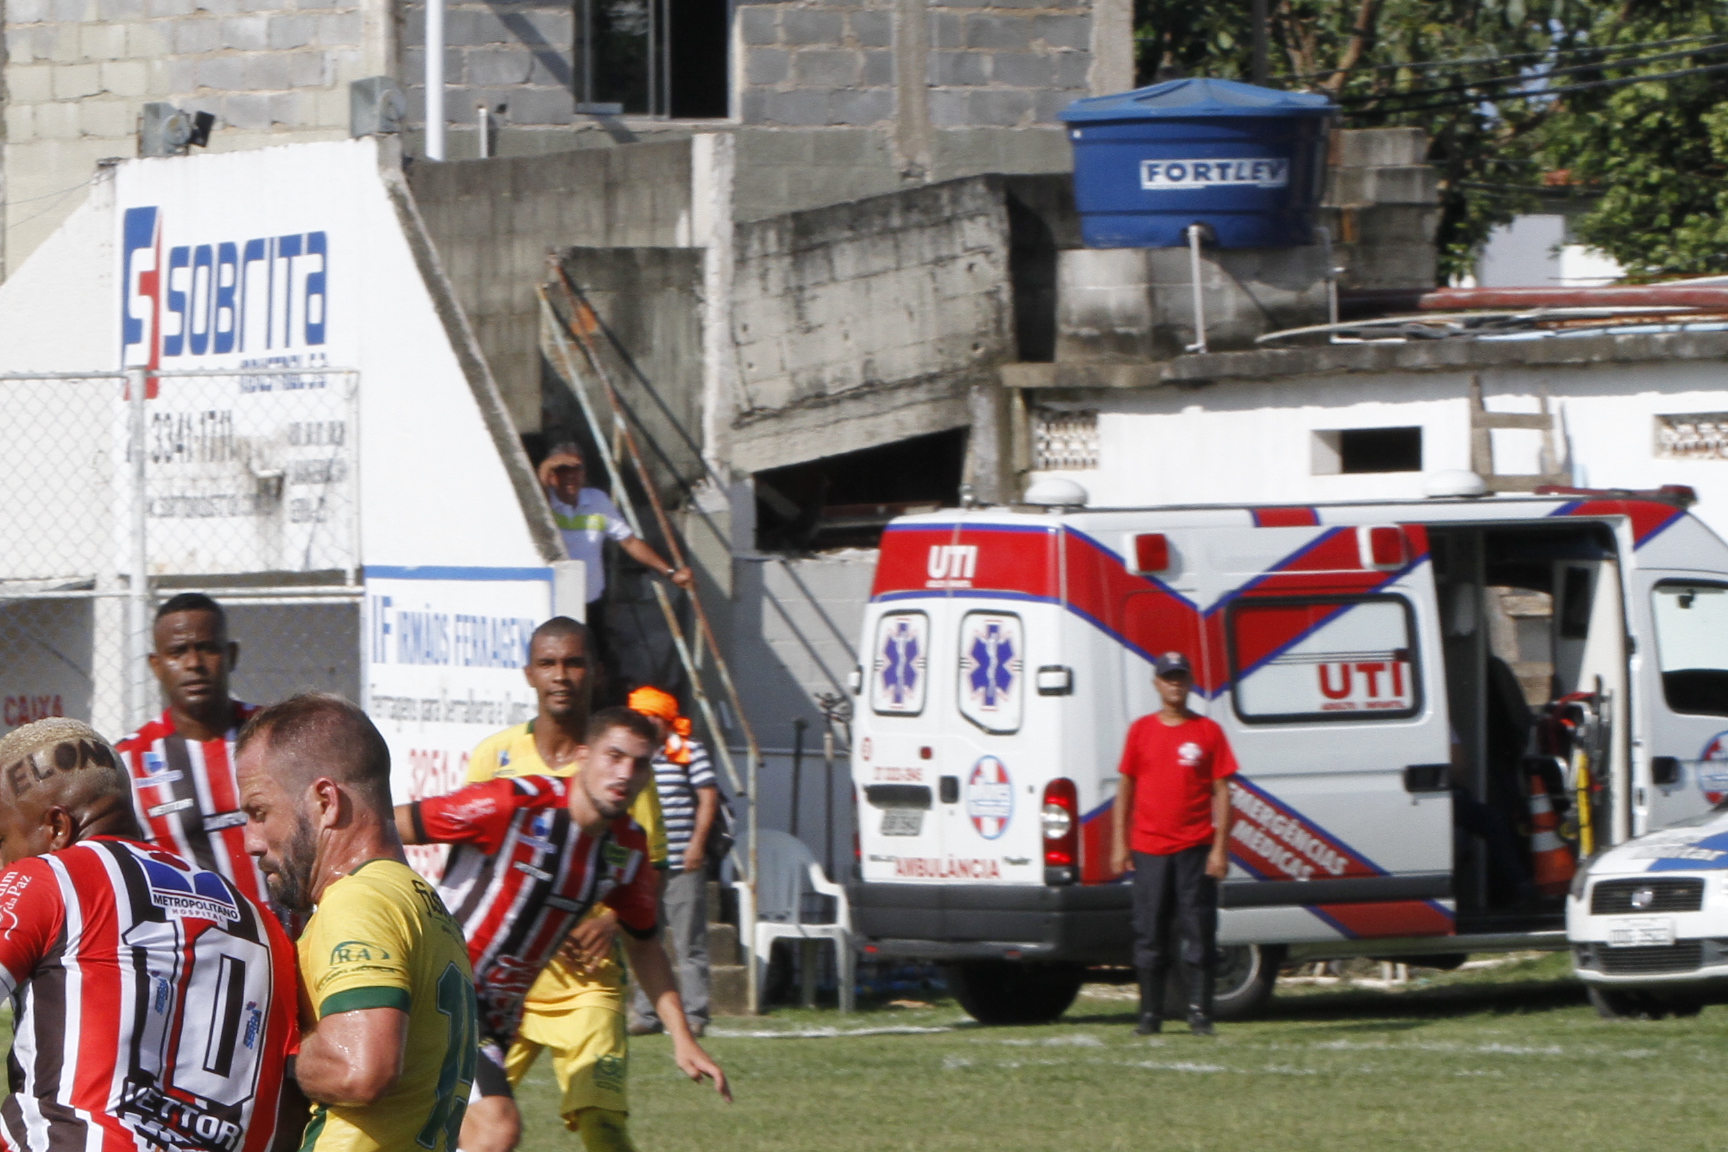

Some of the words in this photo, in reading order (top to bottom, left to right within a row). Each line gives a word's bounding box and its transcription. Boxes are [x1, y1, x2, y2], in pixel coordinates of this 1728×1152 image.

[926, 544, 979, 579] UTI
[455, 613, 534, 670] FERRAGEN
[1318, 660, 1404, 699] UTI
[894, 854, 1000, 878] AMBULÂNCIA
[6, 874, 32, 897] Paz
[153, 894, 238, 920] METROPOLITANO
[172, 908, 224, 923] HOSPITAL
[122, 919, 271, 1107] 10
